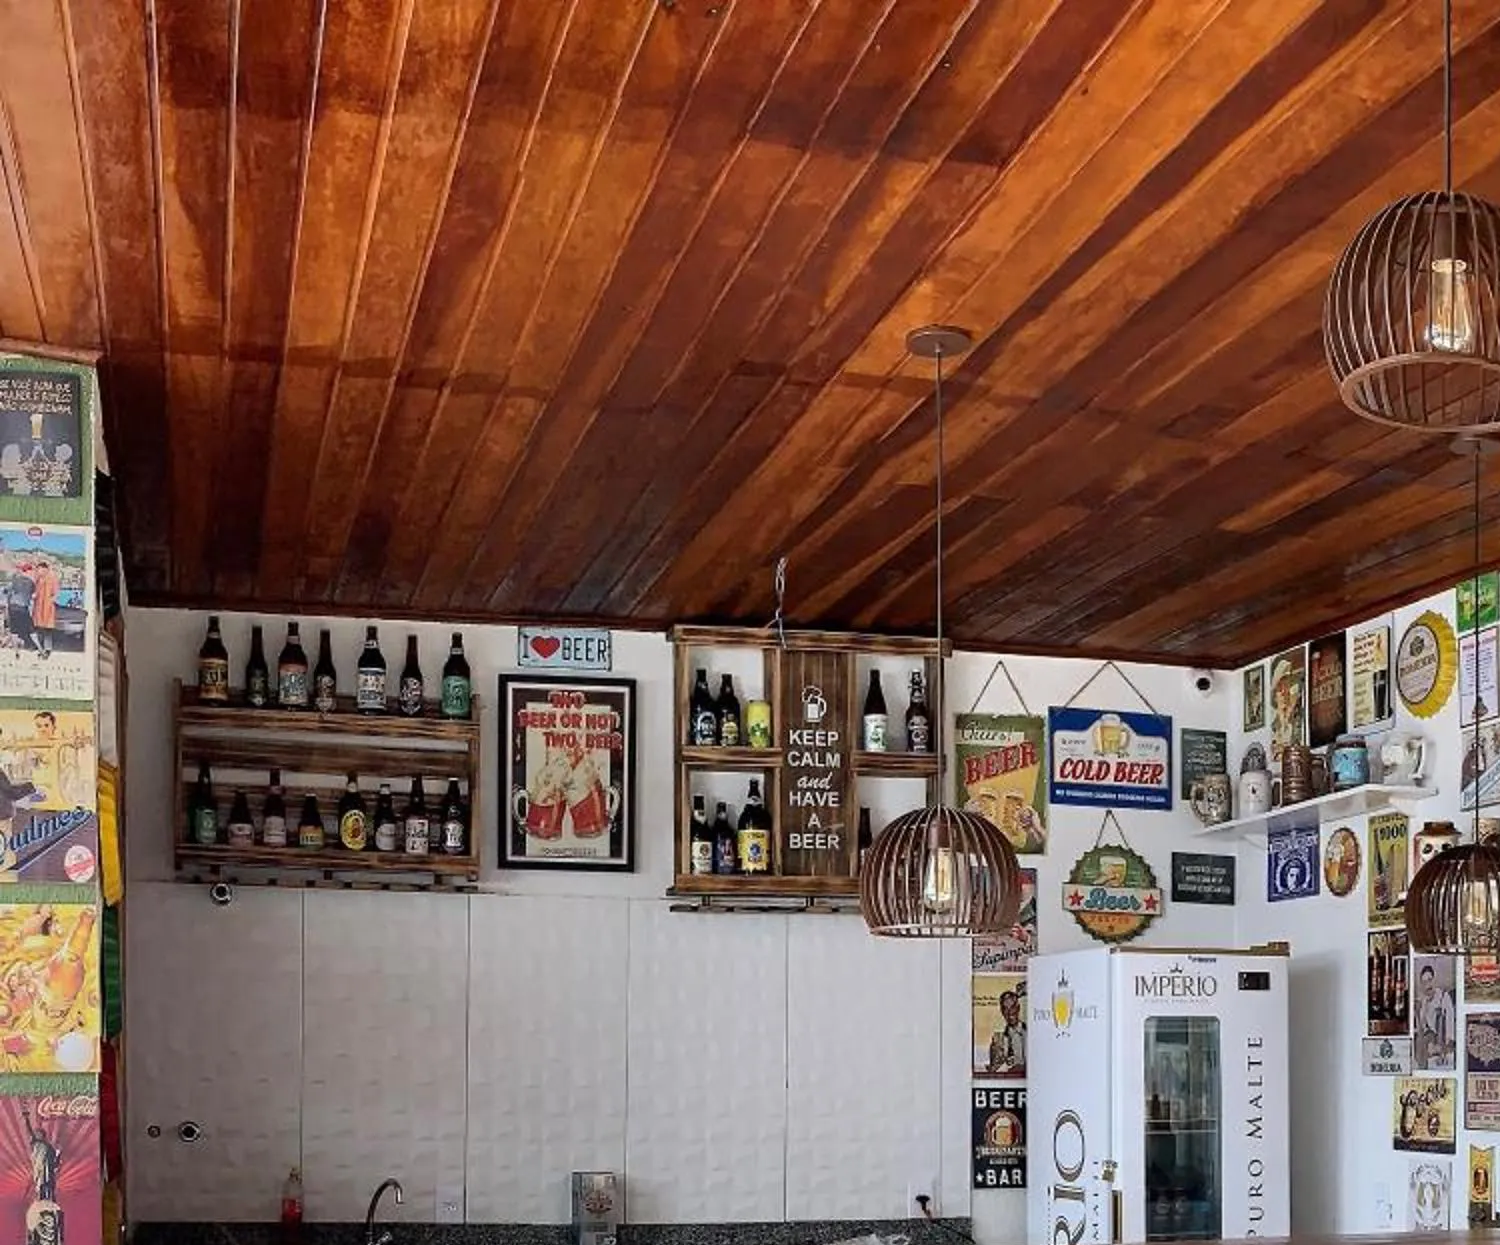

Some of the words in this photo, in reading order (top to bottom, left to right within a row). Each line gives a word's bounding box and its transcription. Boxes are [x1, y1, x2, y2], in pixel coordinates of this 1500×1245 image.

[562, 637, 606, 662] BEER
[517, 710, 556, 729] BEER
[560, 711, 582, 729] OR
[789, 729, 839, 747] KEEP
[788, 751, 840, 768] CALM
[965, 742, 1039, 785] BEER
[797, 771, 833, 790] and
[1059, 758, 1111, 782] COLD
[1114, 759, 1164, 785] BEER
[789, 791, 840, 807] HAVE
[807, 812, 821, 828] A
[789, 833, 840, 849] BEER
[1084, 887, 1141, 911] Beer
[1247, 1037, 1263, 1139] MALTE
[986, 1169, 1022, 1185] BAR
